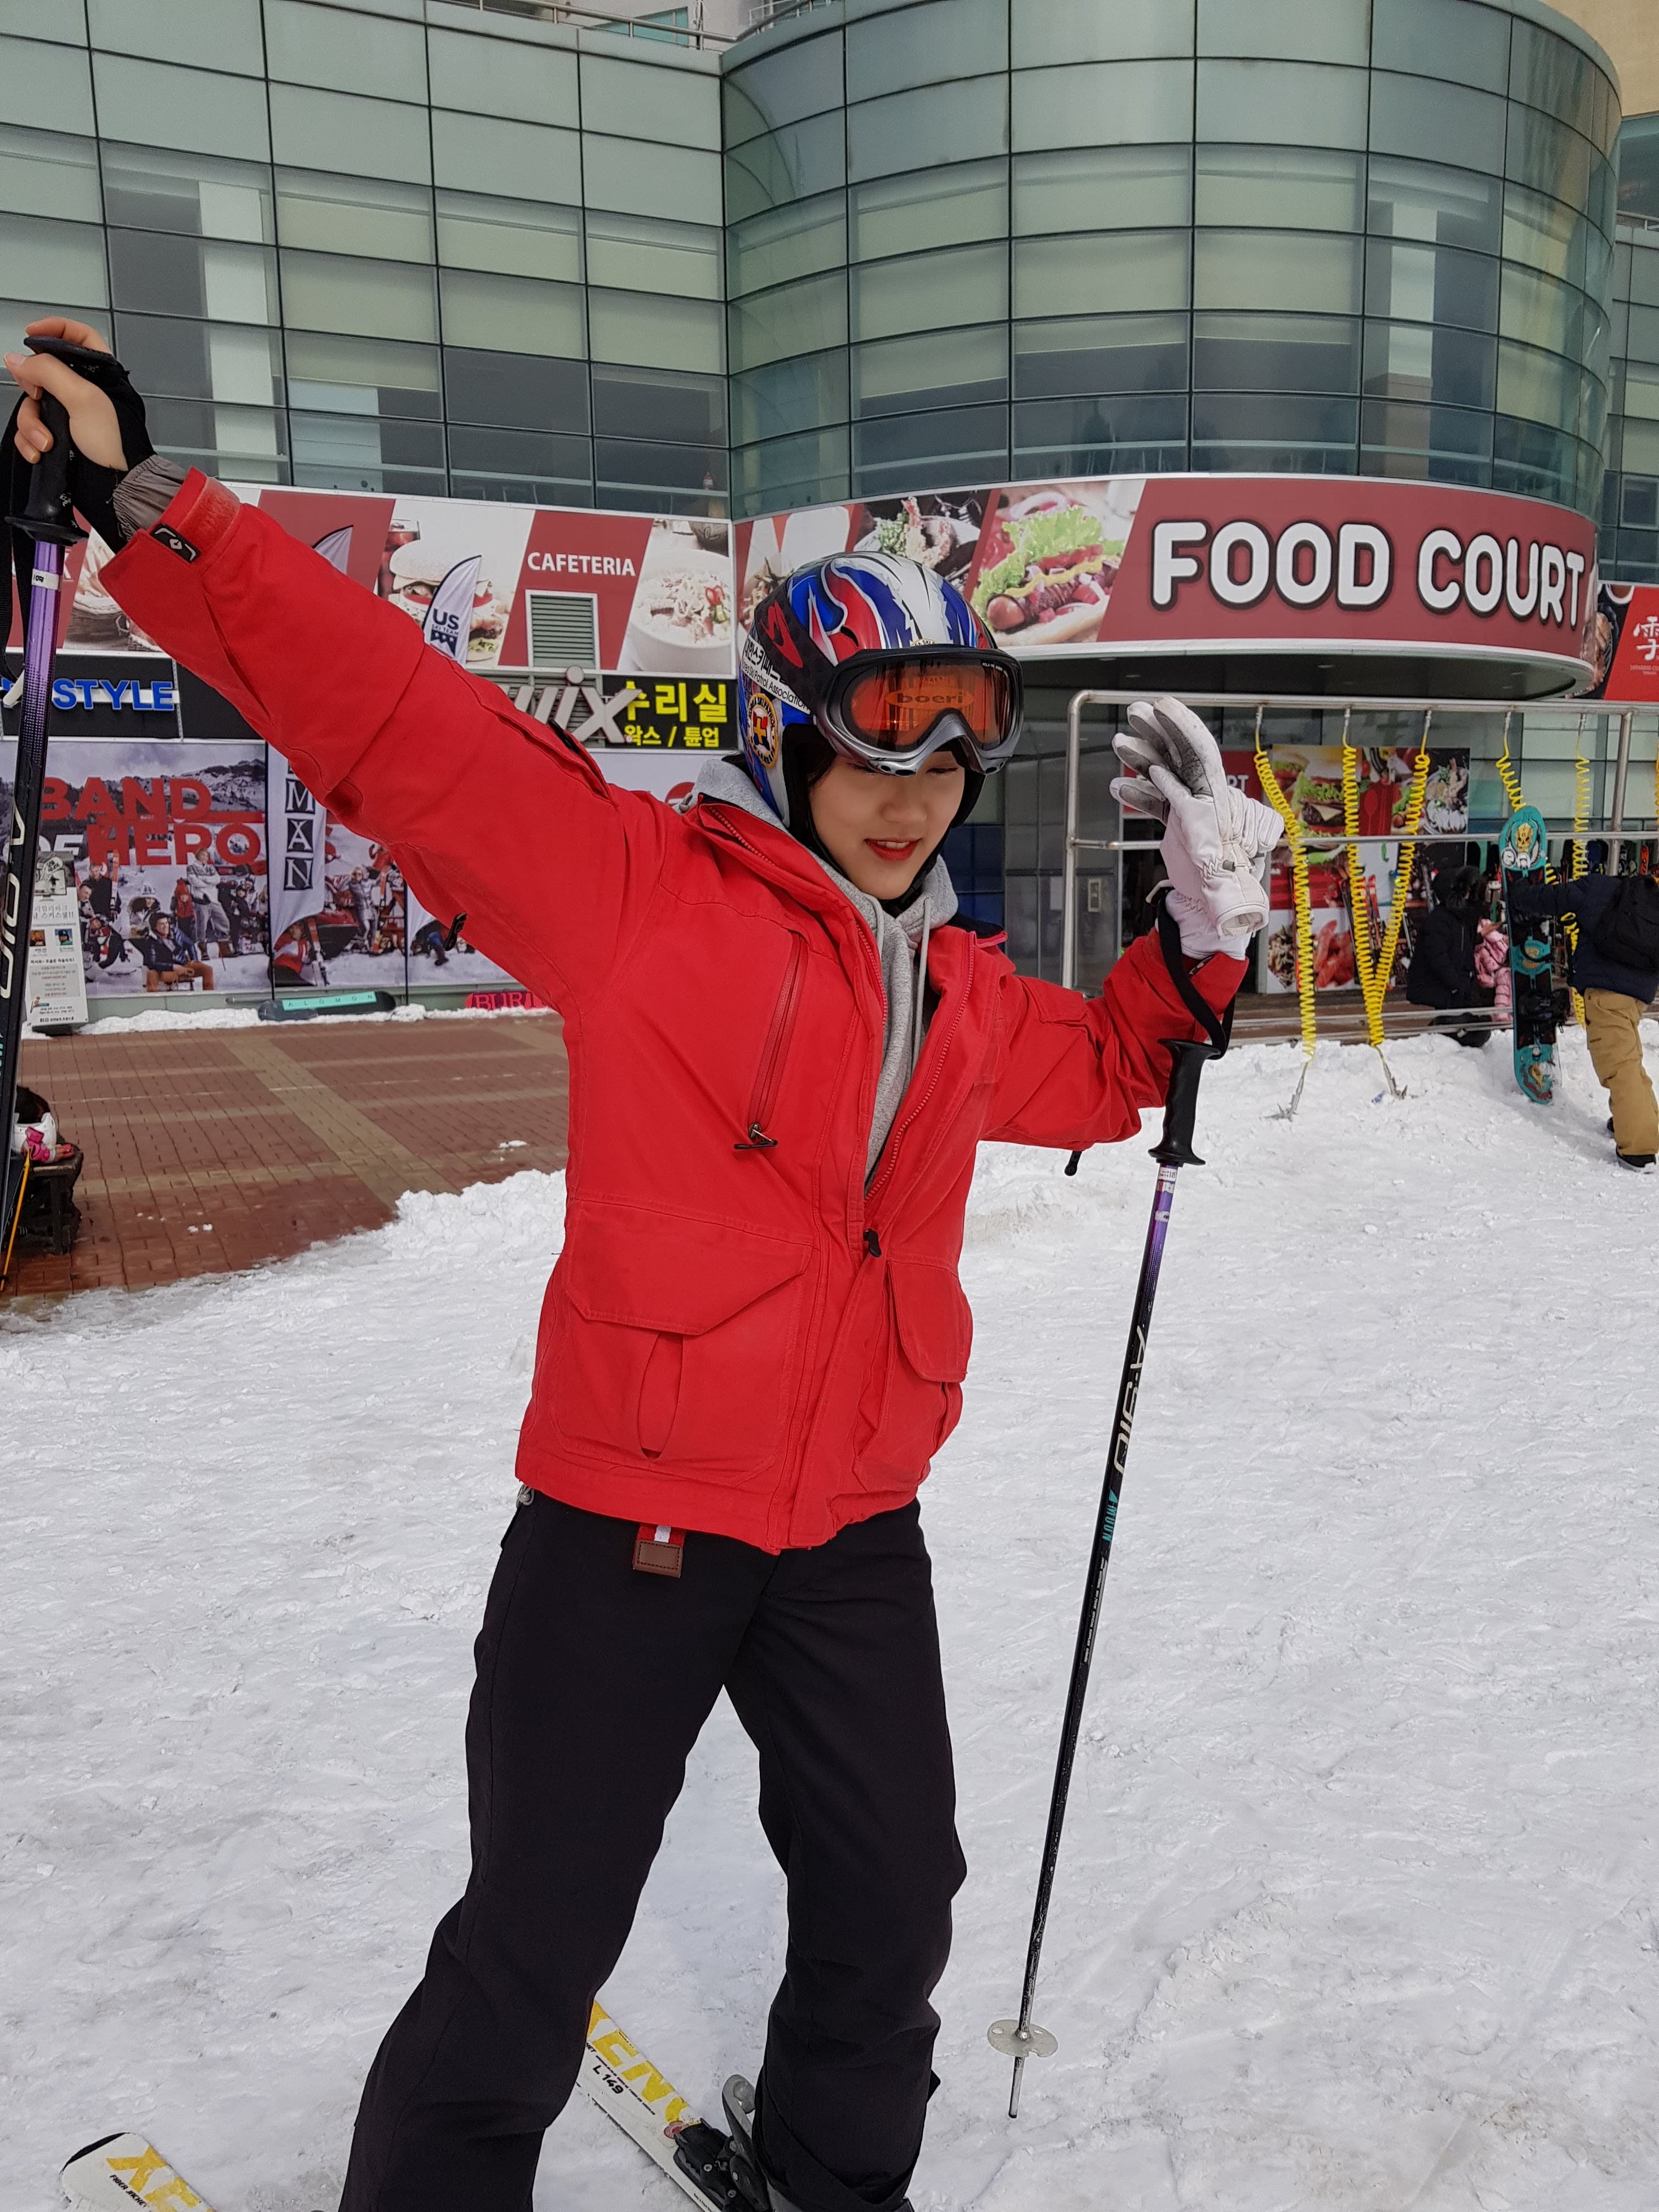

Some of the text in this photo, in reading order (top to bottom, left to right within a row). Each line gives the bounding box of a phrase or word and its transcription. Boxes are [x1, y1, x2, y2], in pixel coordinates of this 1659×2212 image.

[527, 552, 636, 576] CAFETERIA
[1152, 520, 1585, 628] FOOD COURT
[433, 608, 460, 630] US
[52, 678, 176, 711] STYLE
[754, 669, 769, 689] Patrol
[625, 680, 728, 723] 수리실
[897, 691, 963, 704] boeri
[40, 776, 213, 820] BAND
[87, 823, 261, 866] HERO
[592, 2064, 624, 2095] L 149
